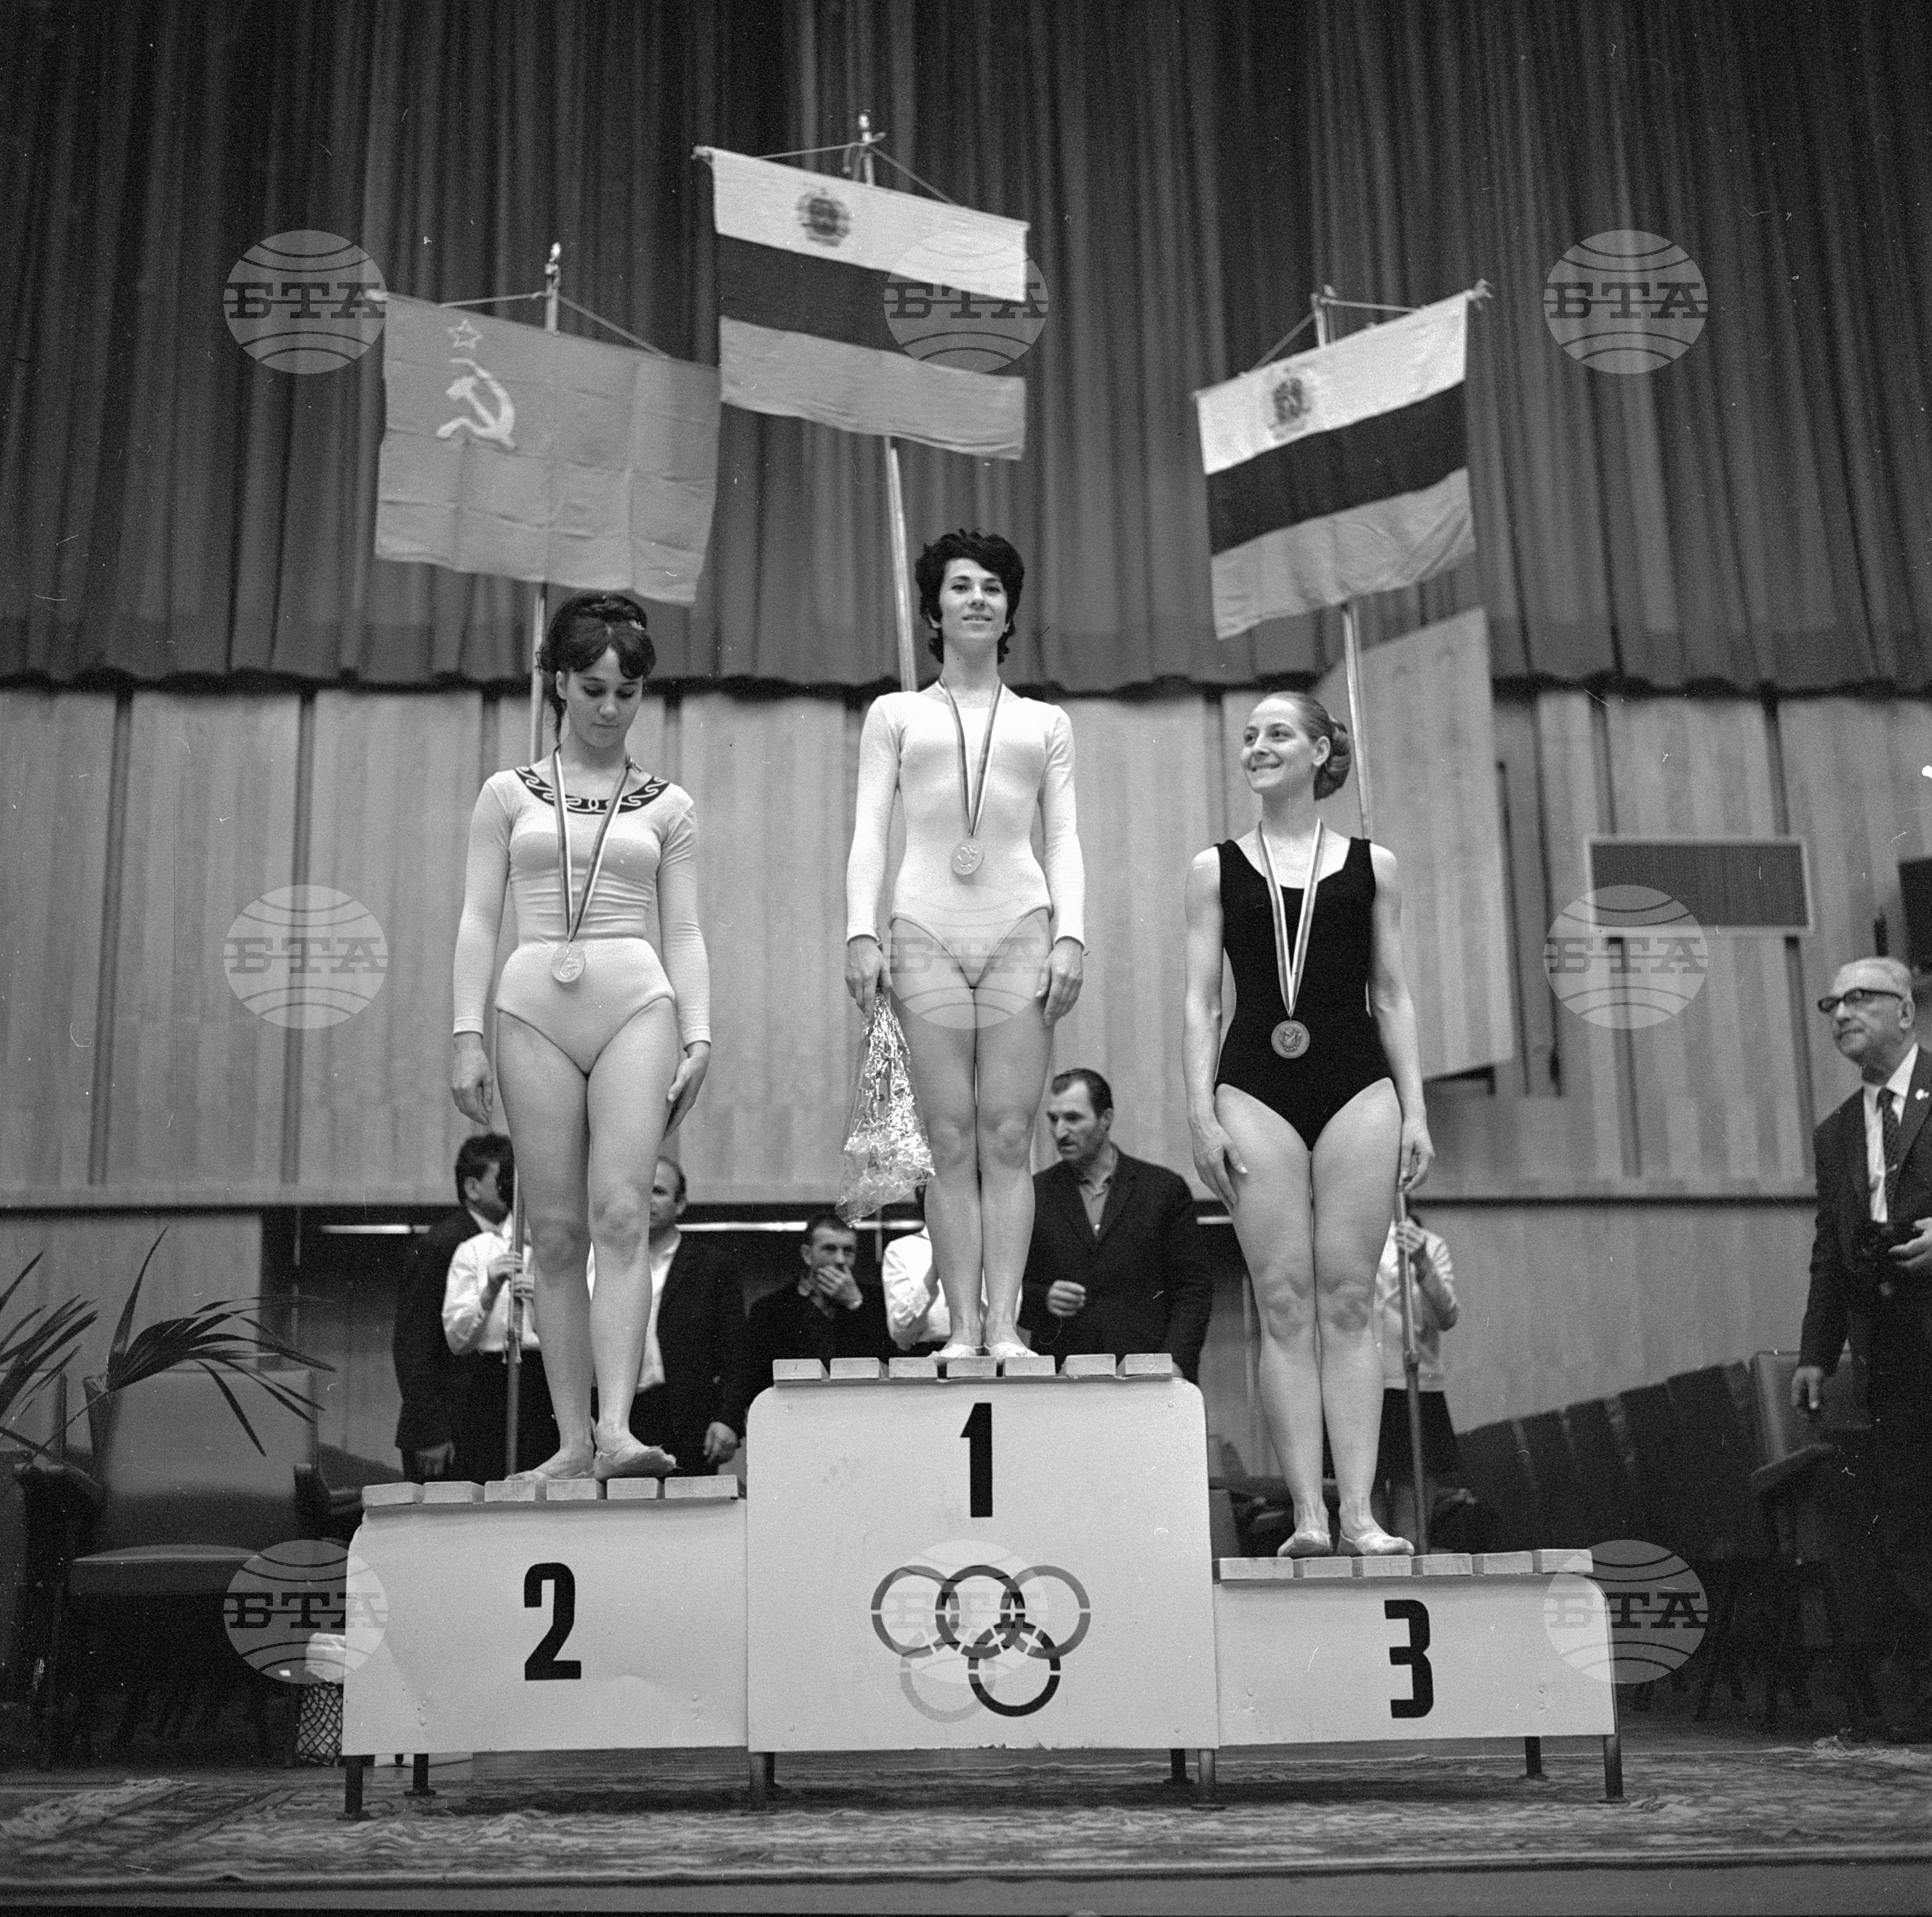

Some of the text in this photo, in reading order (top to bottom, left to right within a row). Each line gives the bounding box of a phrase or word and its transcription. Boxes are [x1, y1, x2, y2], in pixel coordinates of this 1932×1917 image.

[960, 1402, 993, 1518] 1
[524, 1562, 582, 1681] 2
[1384, 1599, 1434, 1718] 3
